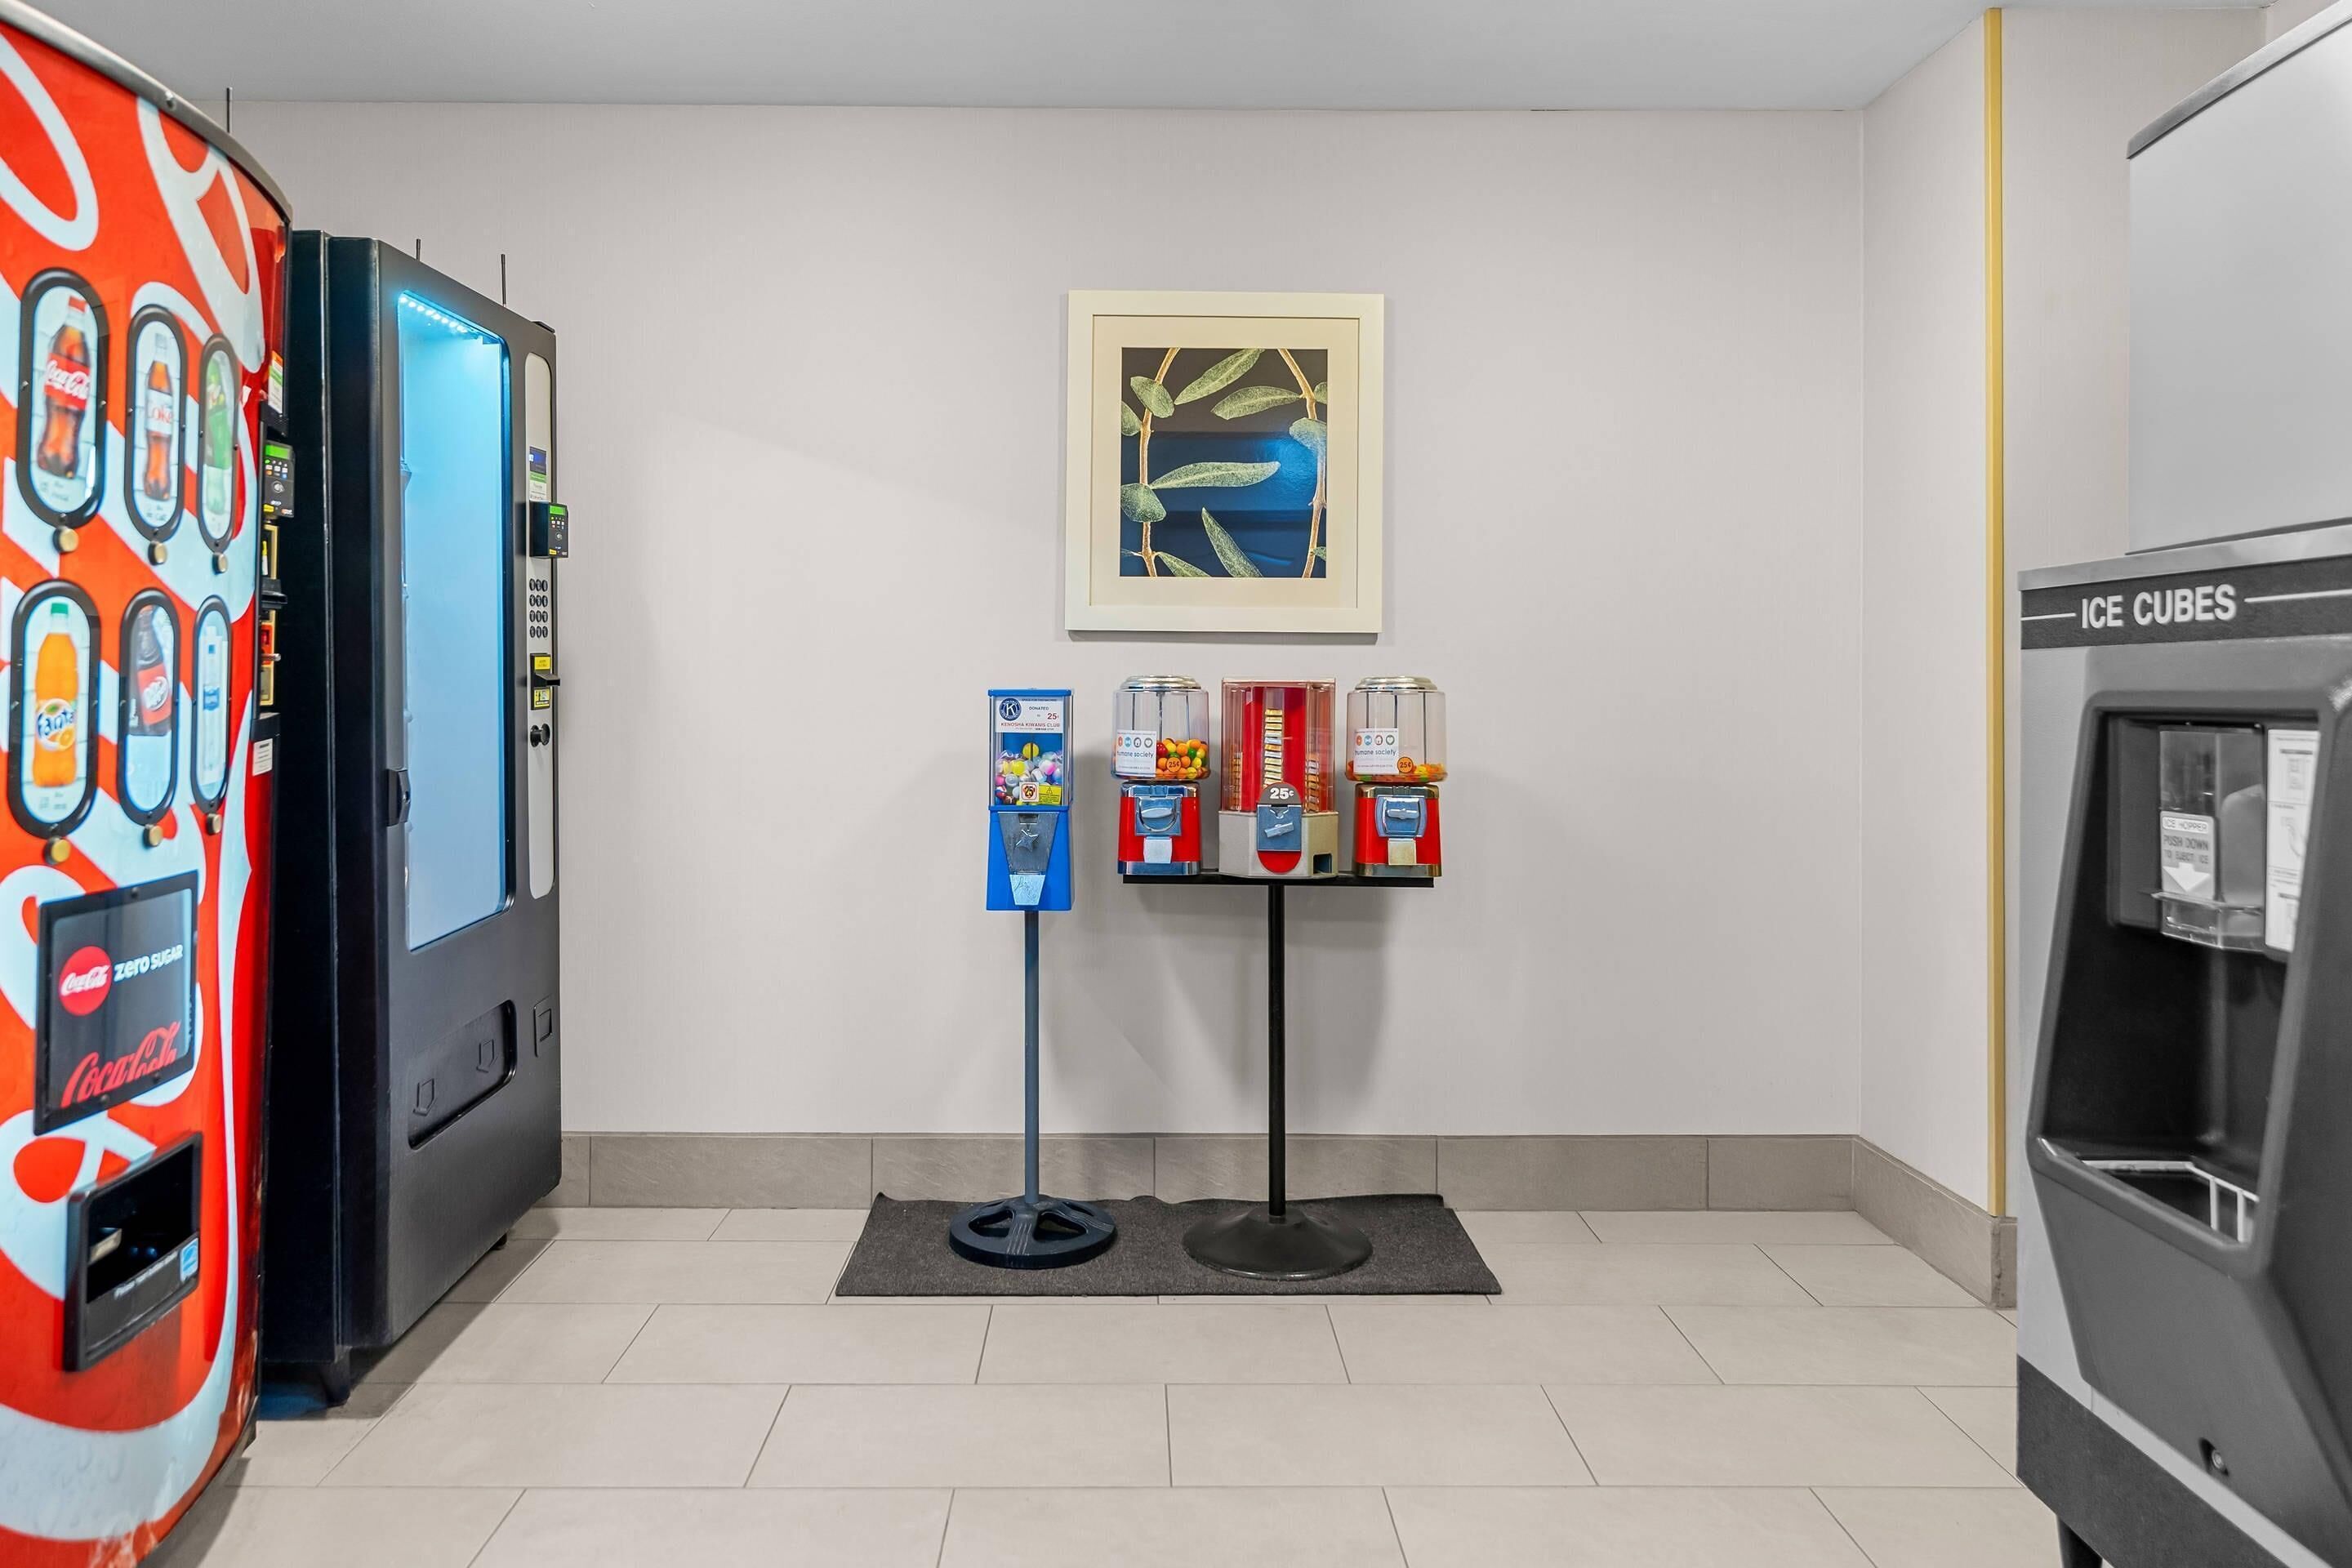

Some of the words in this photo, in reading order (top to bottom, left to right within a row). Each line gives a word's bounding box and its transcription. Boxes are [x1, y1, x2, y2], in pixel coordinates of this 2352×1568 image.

[2081, 595, 2125, 629] ICE
[2132, 583, 2237, 626] CUBES
[1375, 748, 1396, 756] society
[150, 944, 184, 969] SUGAR
